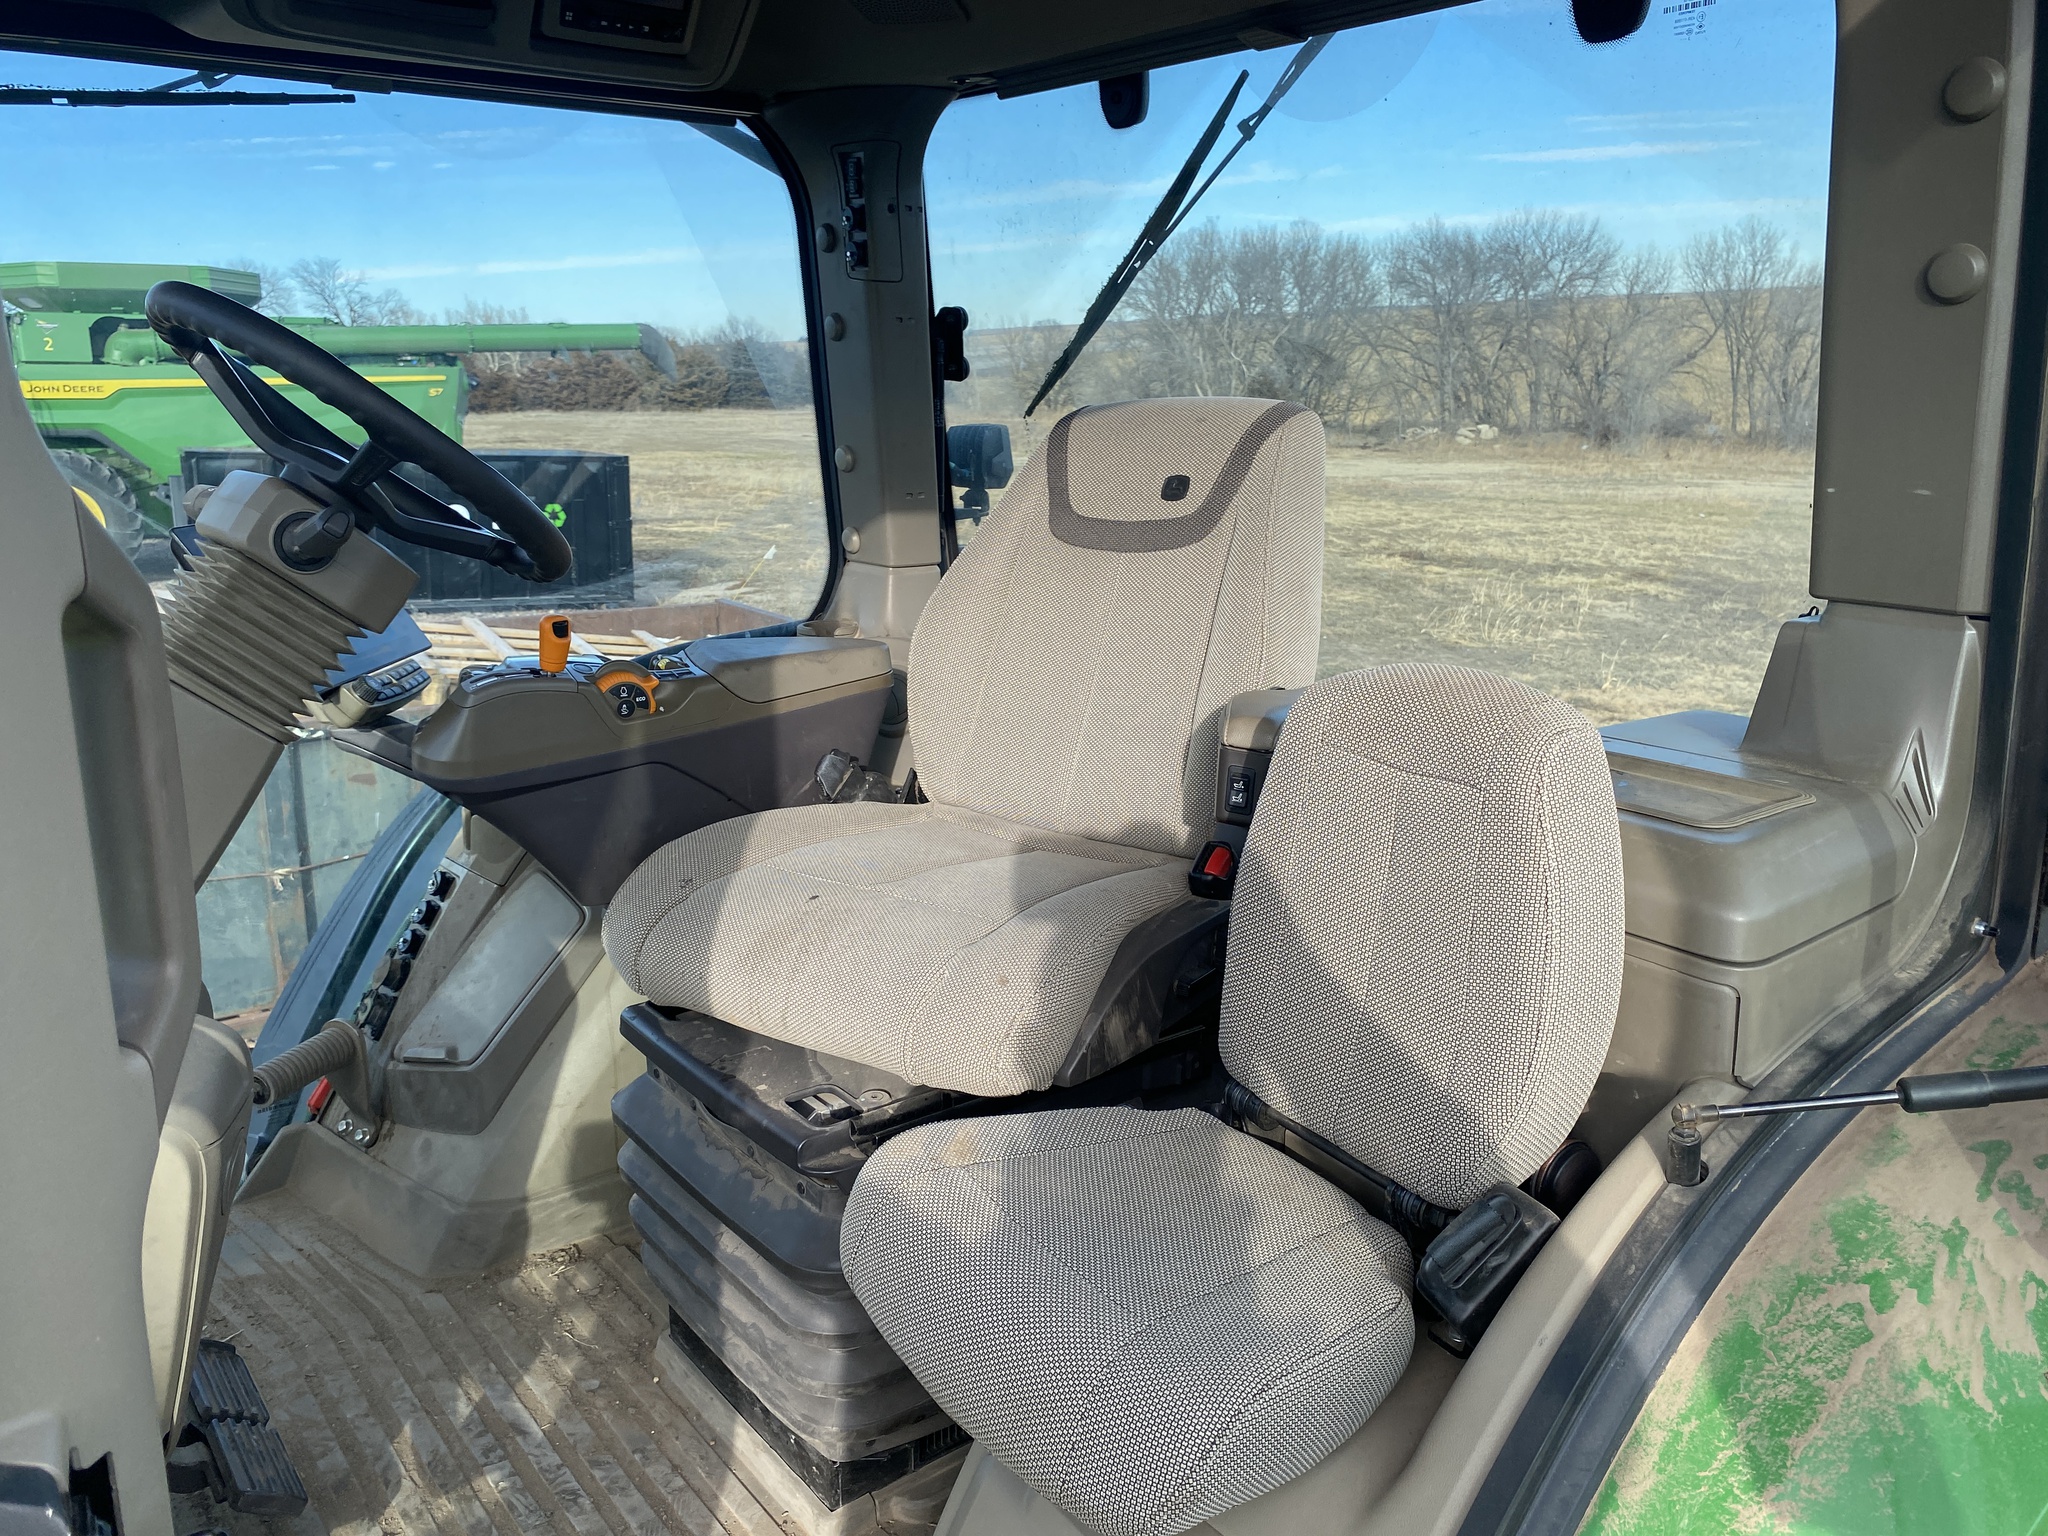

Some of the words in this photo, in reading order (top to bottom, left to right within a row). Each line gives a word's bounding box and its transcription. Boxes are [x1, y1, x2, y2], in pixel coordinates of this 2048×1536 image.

[43, 337, 54, 351] 2
[26, 384, 60, 393] JOHN
[62, 384, 104, 393] DEERE
[428, 388, 444, 397] S7
